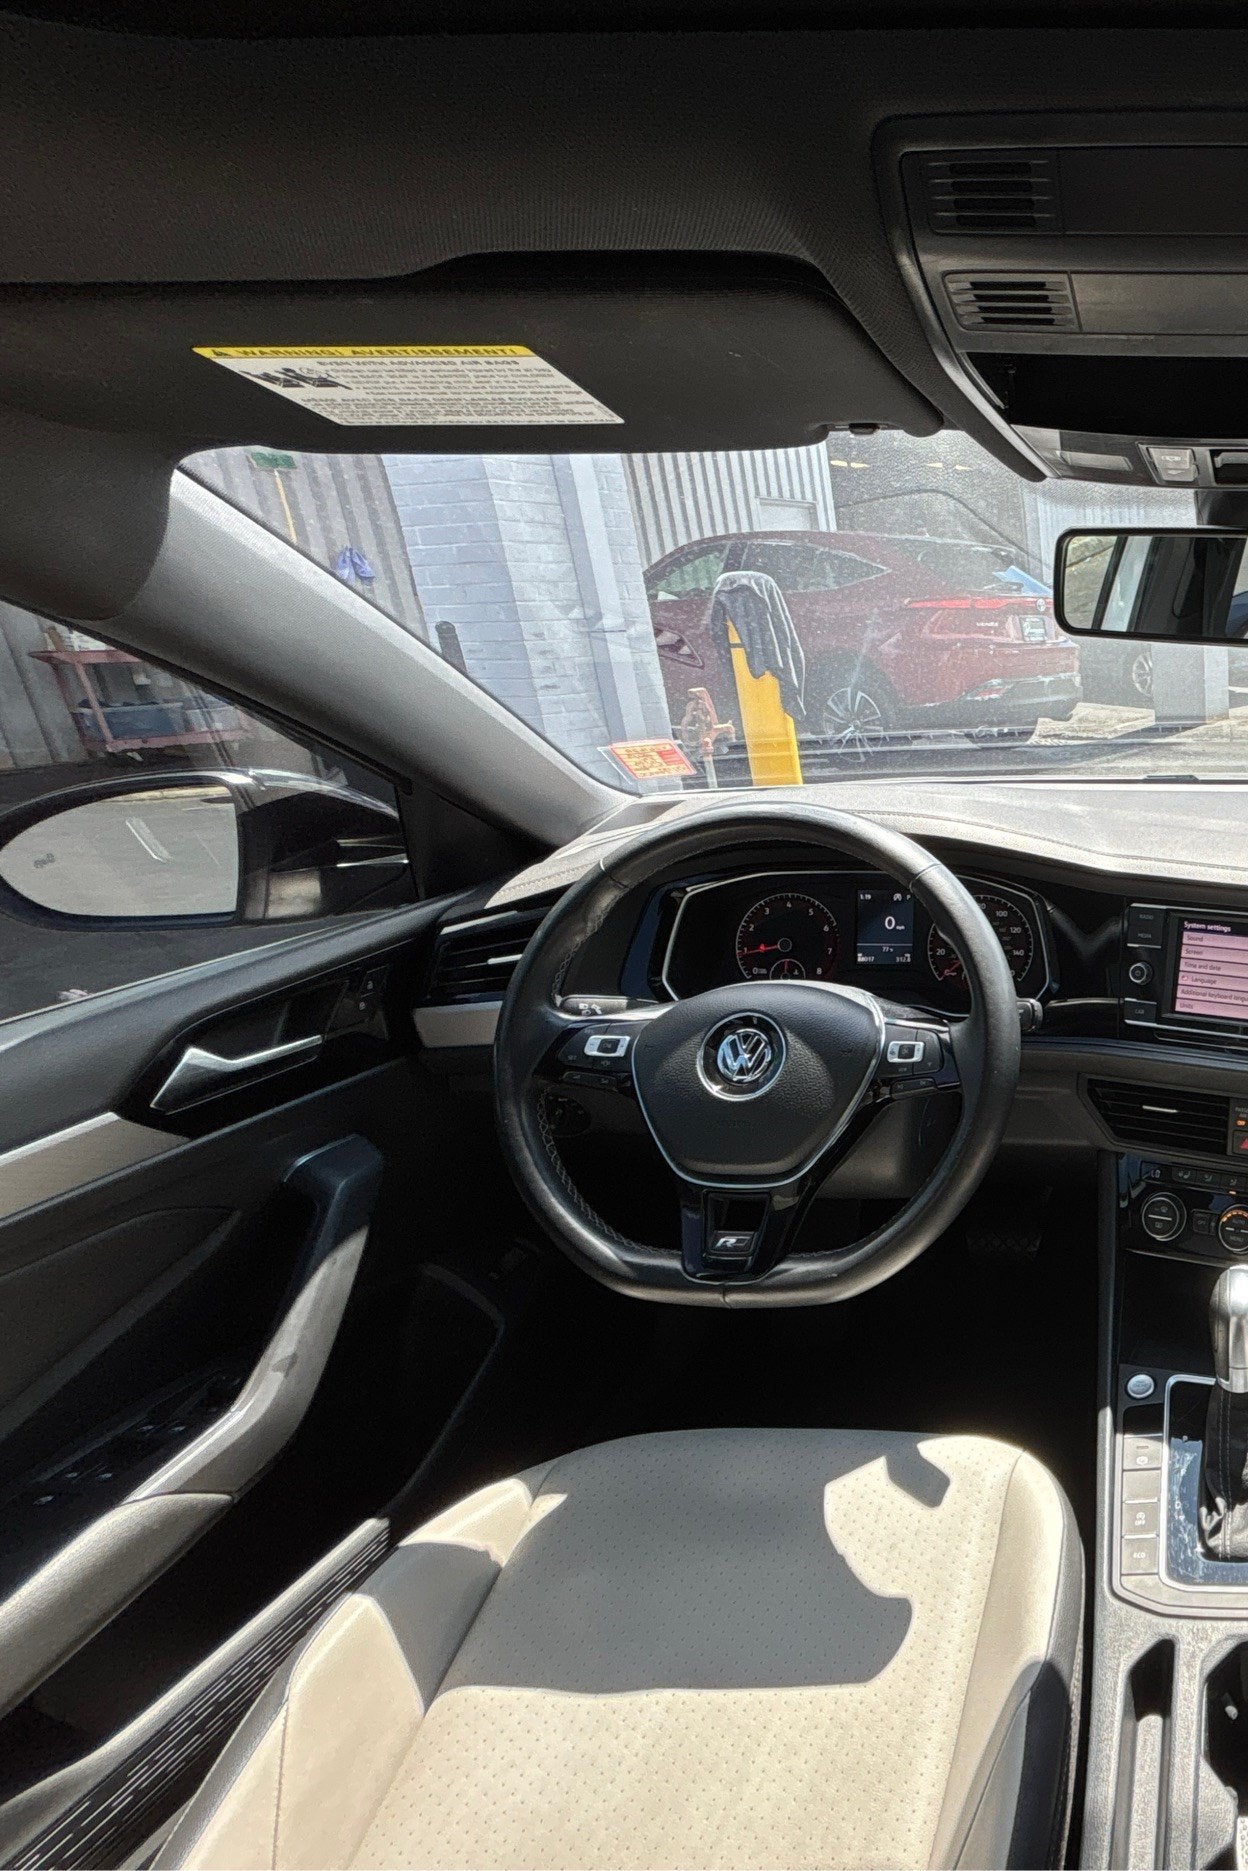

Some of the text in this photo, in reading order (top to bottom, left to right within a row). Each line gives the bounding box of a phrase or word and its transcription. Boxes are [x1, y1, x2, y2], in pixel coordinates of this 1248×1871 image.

[764, 907, 770, 915] 3
[808, 908, 814, 916] 5
[884, 916, 896, 930] 0
[1184, 921, 1231, 932] System settings
[827, 947, 833, 955] 7
[936, 948, 945, 956] 20
[1185, 948, 1203, 956] Screen
[1184, 961, 1197, 969] Time
[816, 967, 822, 975] 8
[1191, 977, 1217, 985] Language
[1180, 989, 1207, 997] Additional
[1208, 991, 1232, 1000] keyboard
